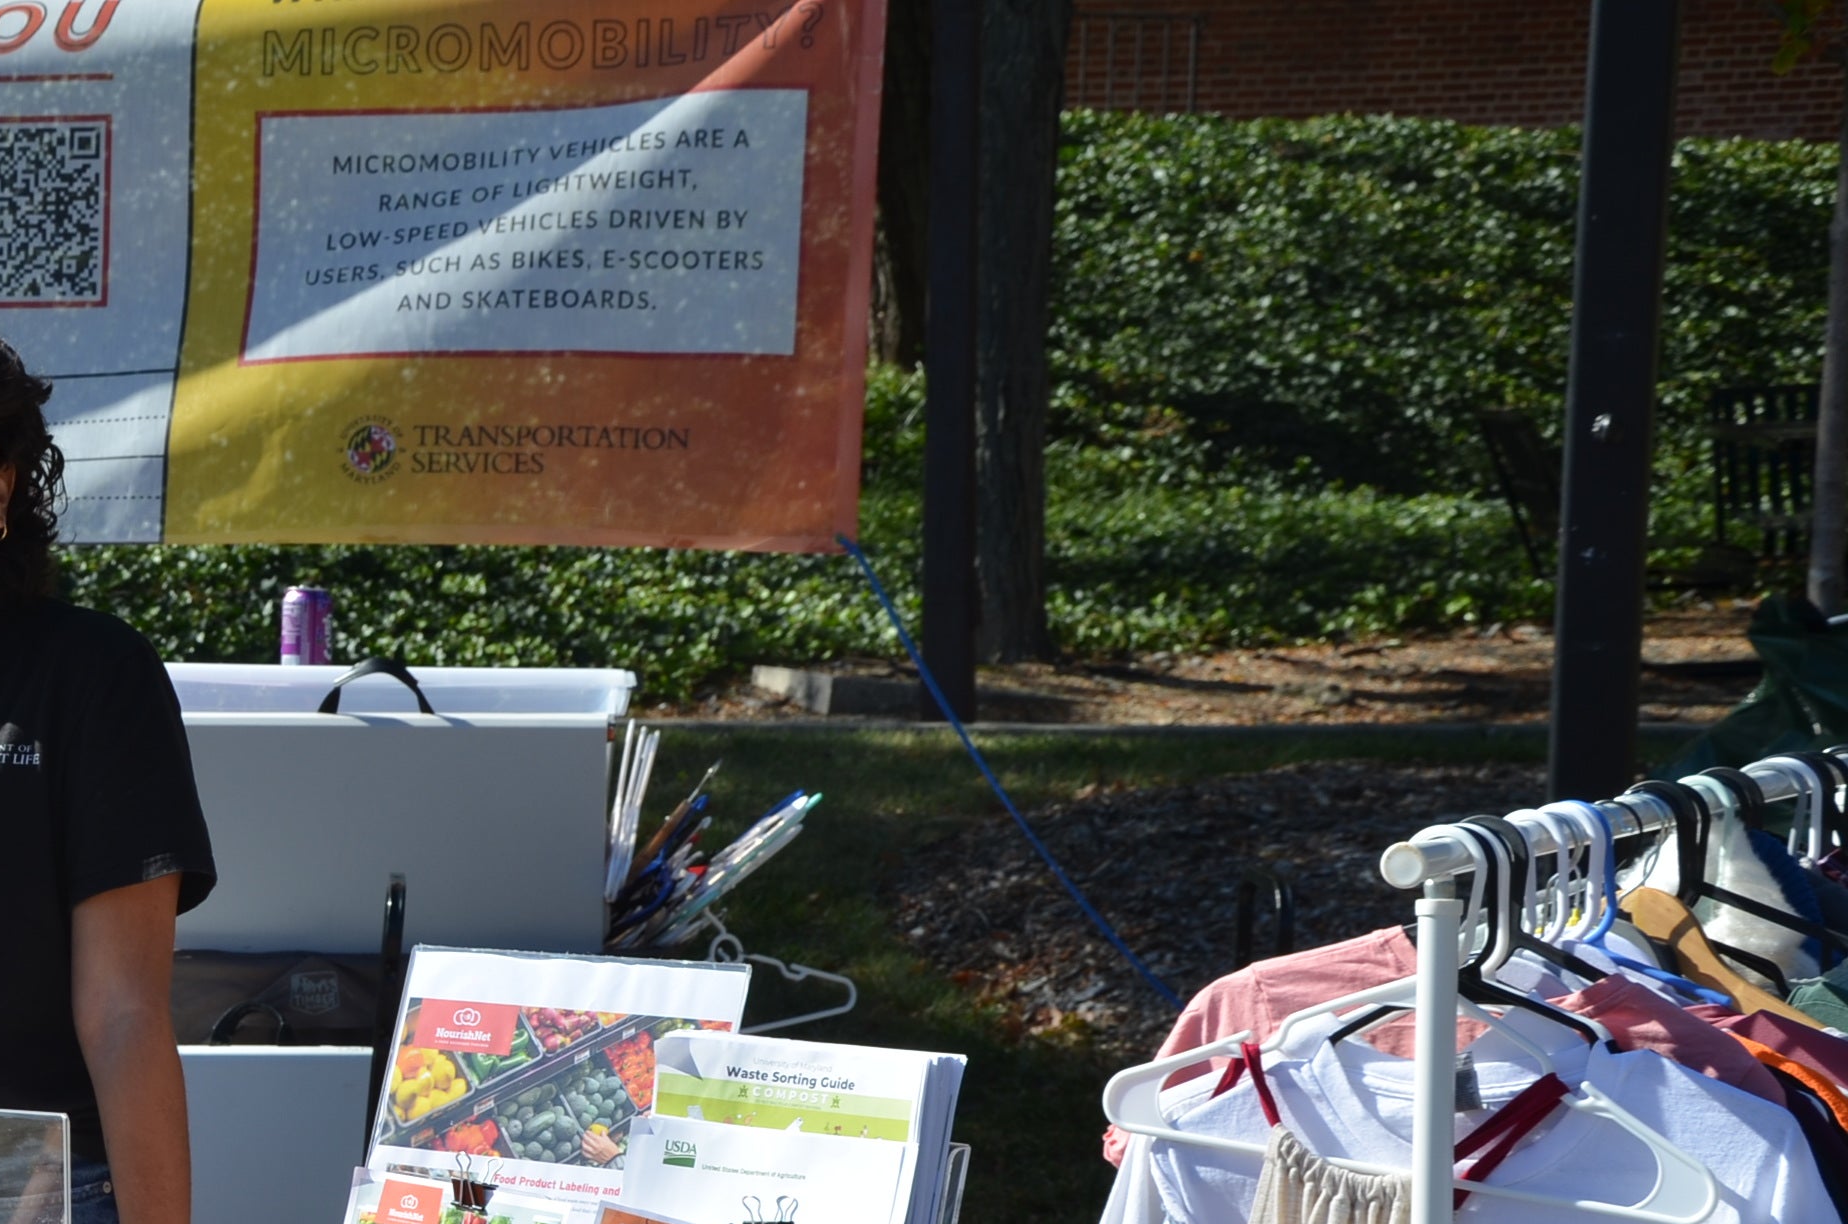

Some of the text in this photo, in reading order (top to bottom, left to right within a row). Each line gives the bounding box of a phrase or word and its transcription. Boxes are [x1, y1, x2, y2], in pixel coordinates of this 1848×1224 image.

[261, 2, 825, 77] MICROMOBILITY?
[332, 128, 750, 176] MICROMOBILITY VEHICLES ARE A
[378, 168, 698, 213] RANGE OF LIGHTWEIGHT,
[326, 209, 749, 252] LOW-SPEED VEHICLES DRIVEN BY
[306, 248, 764, 287] USERS, SUCH AS BIKES, E-SCOOTERS
[397, 288, 658, 313] AND SKATEBOARDS.
[412, 425, 690, 452] TRANSPORTATION
[411, 451, 545, 475] SERVICES
[726, 1065, 856, 1091] Waste Sorting Guide
[752, 1085, 831, 1105] COMPOST
[665, 1139, 697, 1155] USDA
[494, 1173, 620, 1197] Food Product Labeling and
